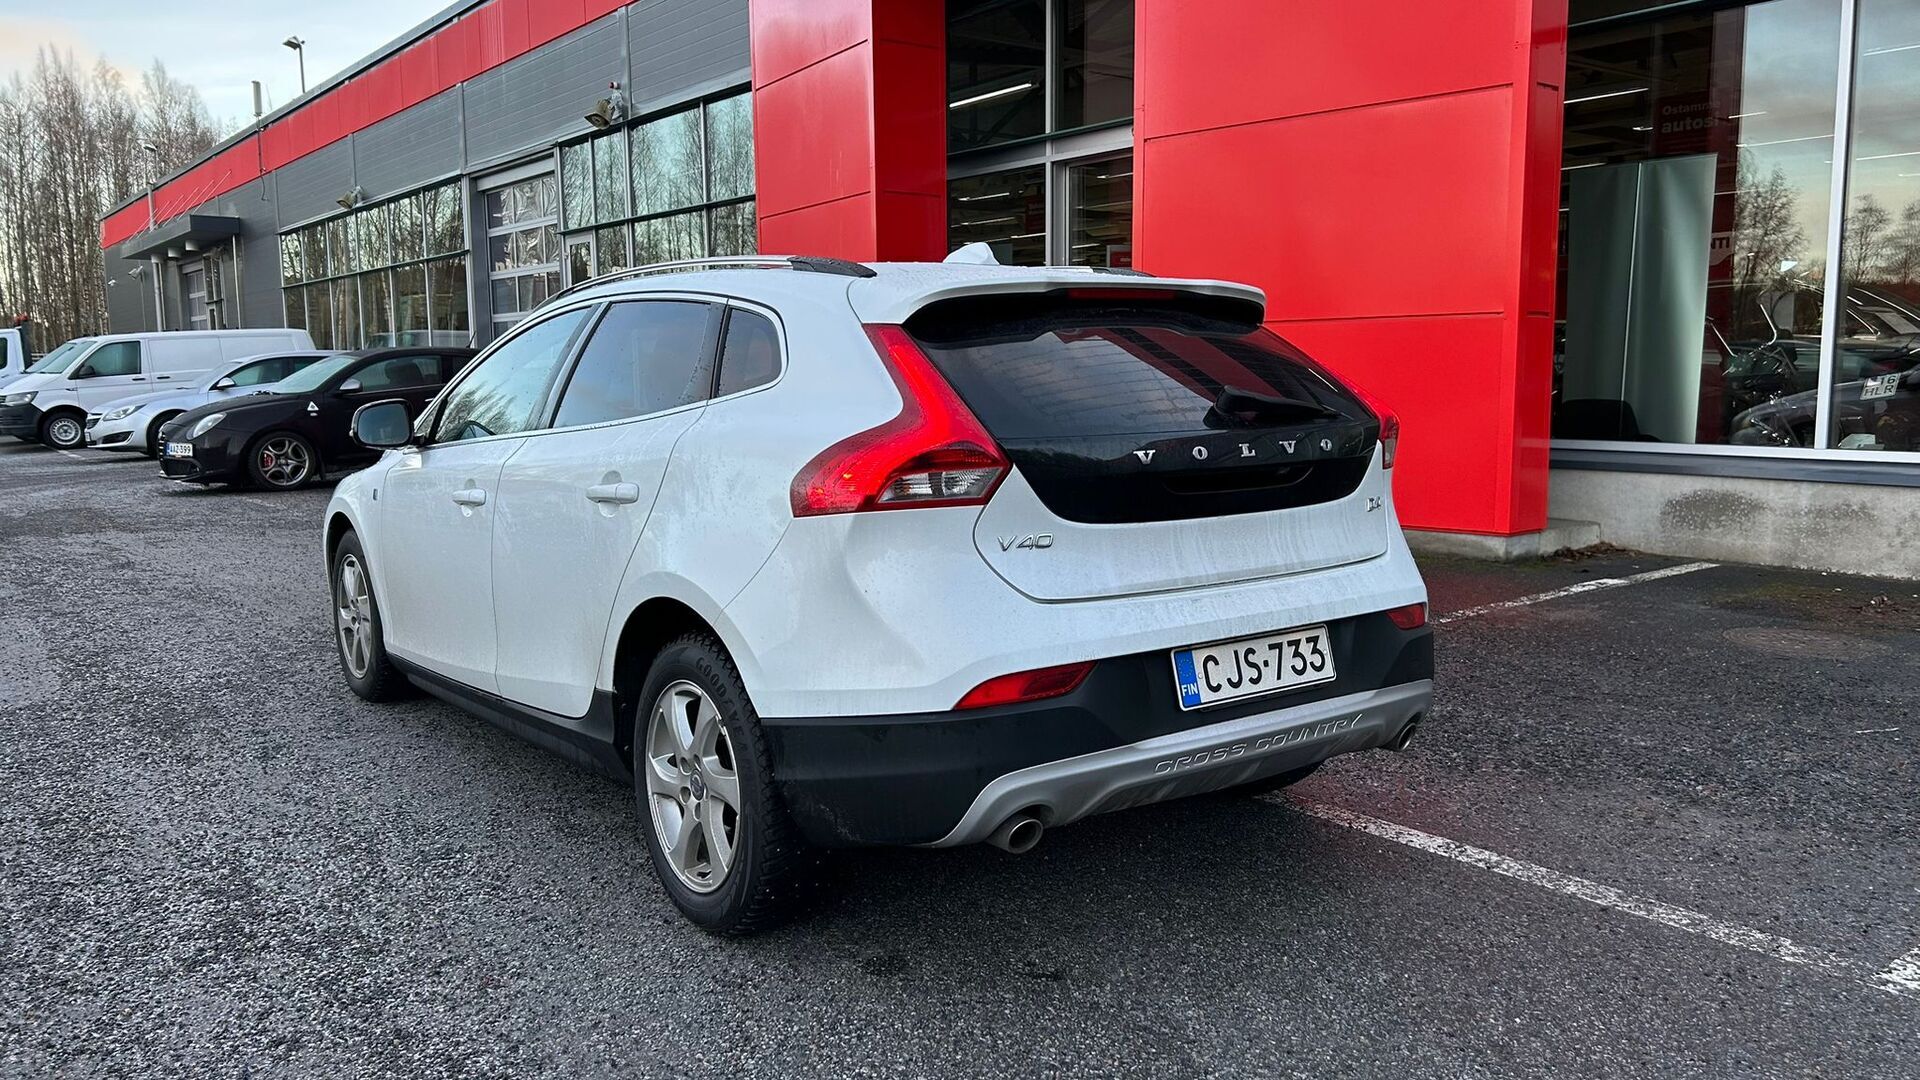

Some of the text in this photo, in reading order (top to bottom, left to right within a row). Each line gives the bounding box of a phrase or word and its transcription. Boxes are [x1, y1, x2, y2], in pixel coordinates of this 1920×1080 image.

[1133, 438, 1333, 465] VOLVO
[996, 532, 1054, 552] V40
[1202, 634, 1326, 694] CJS-733
[1181, 682, 1199, 697] FIN
[1154, 713, 1363, 776] CROSS COUNTRY
